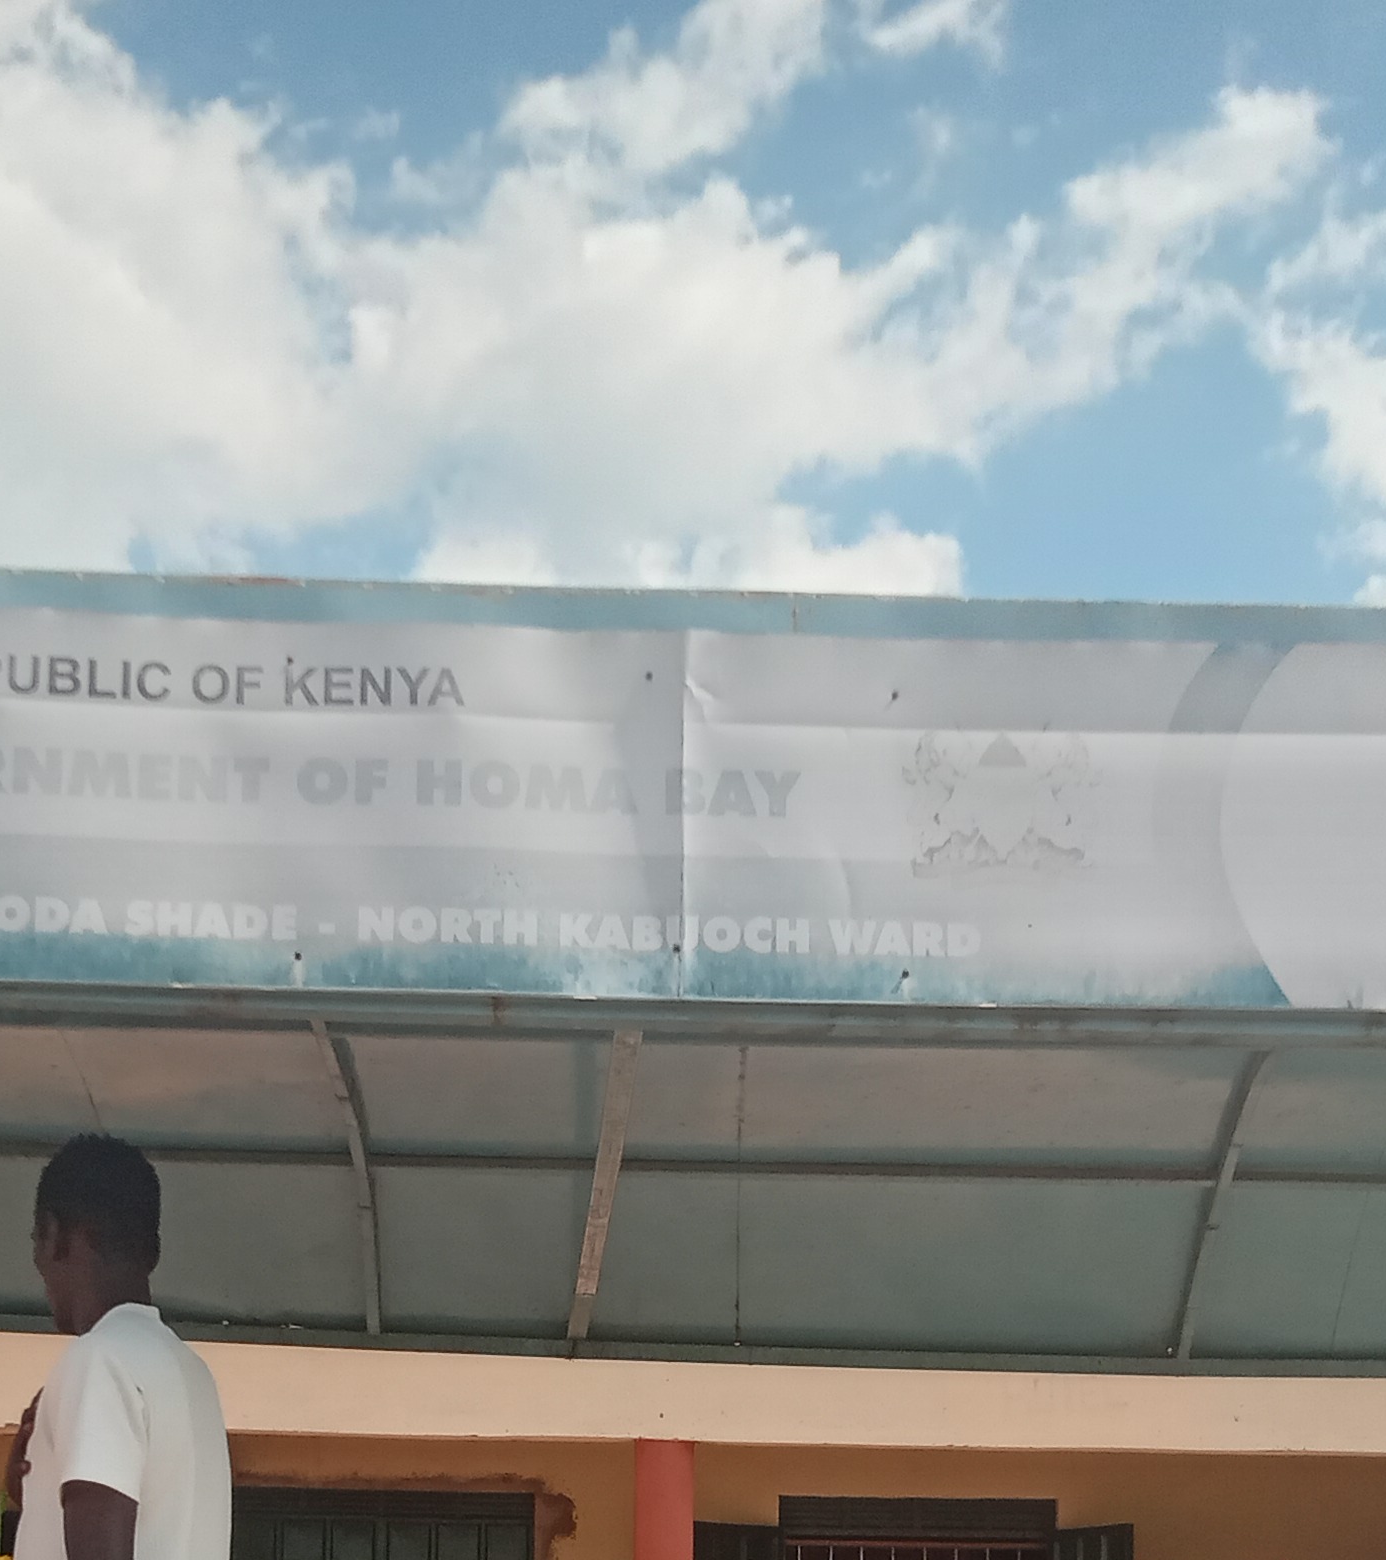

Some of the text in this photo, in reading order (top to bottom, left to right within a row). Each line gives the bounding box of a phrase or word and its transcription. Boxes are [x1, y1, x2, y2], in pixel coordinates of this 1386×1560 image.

[191, 664, 264, 702] OF
[283, 665, 465, 706] KENYA
[295, 757, 389, 805] OF
[416, 759, 637, 817] HOMA
[663, 769, 801, 819] BAY
[125, 900, 297, 940] SHADE
[319, 921, 336, 935] -
[357, 905, 539, 946] NORTH
[559, 912, 811, 954] KABUOCH
[828, 918, 982, 957] WARD
